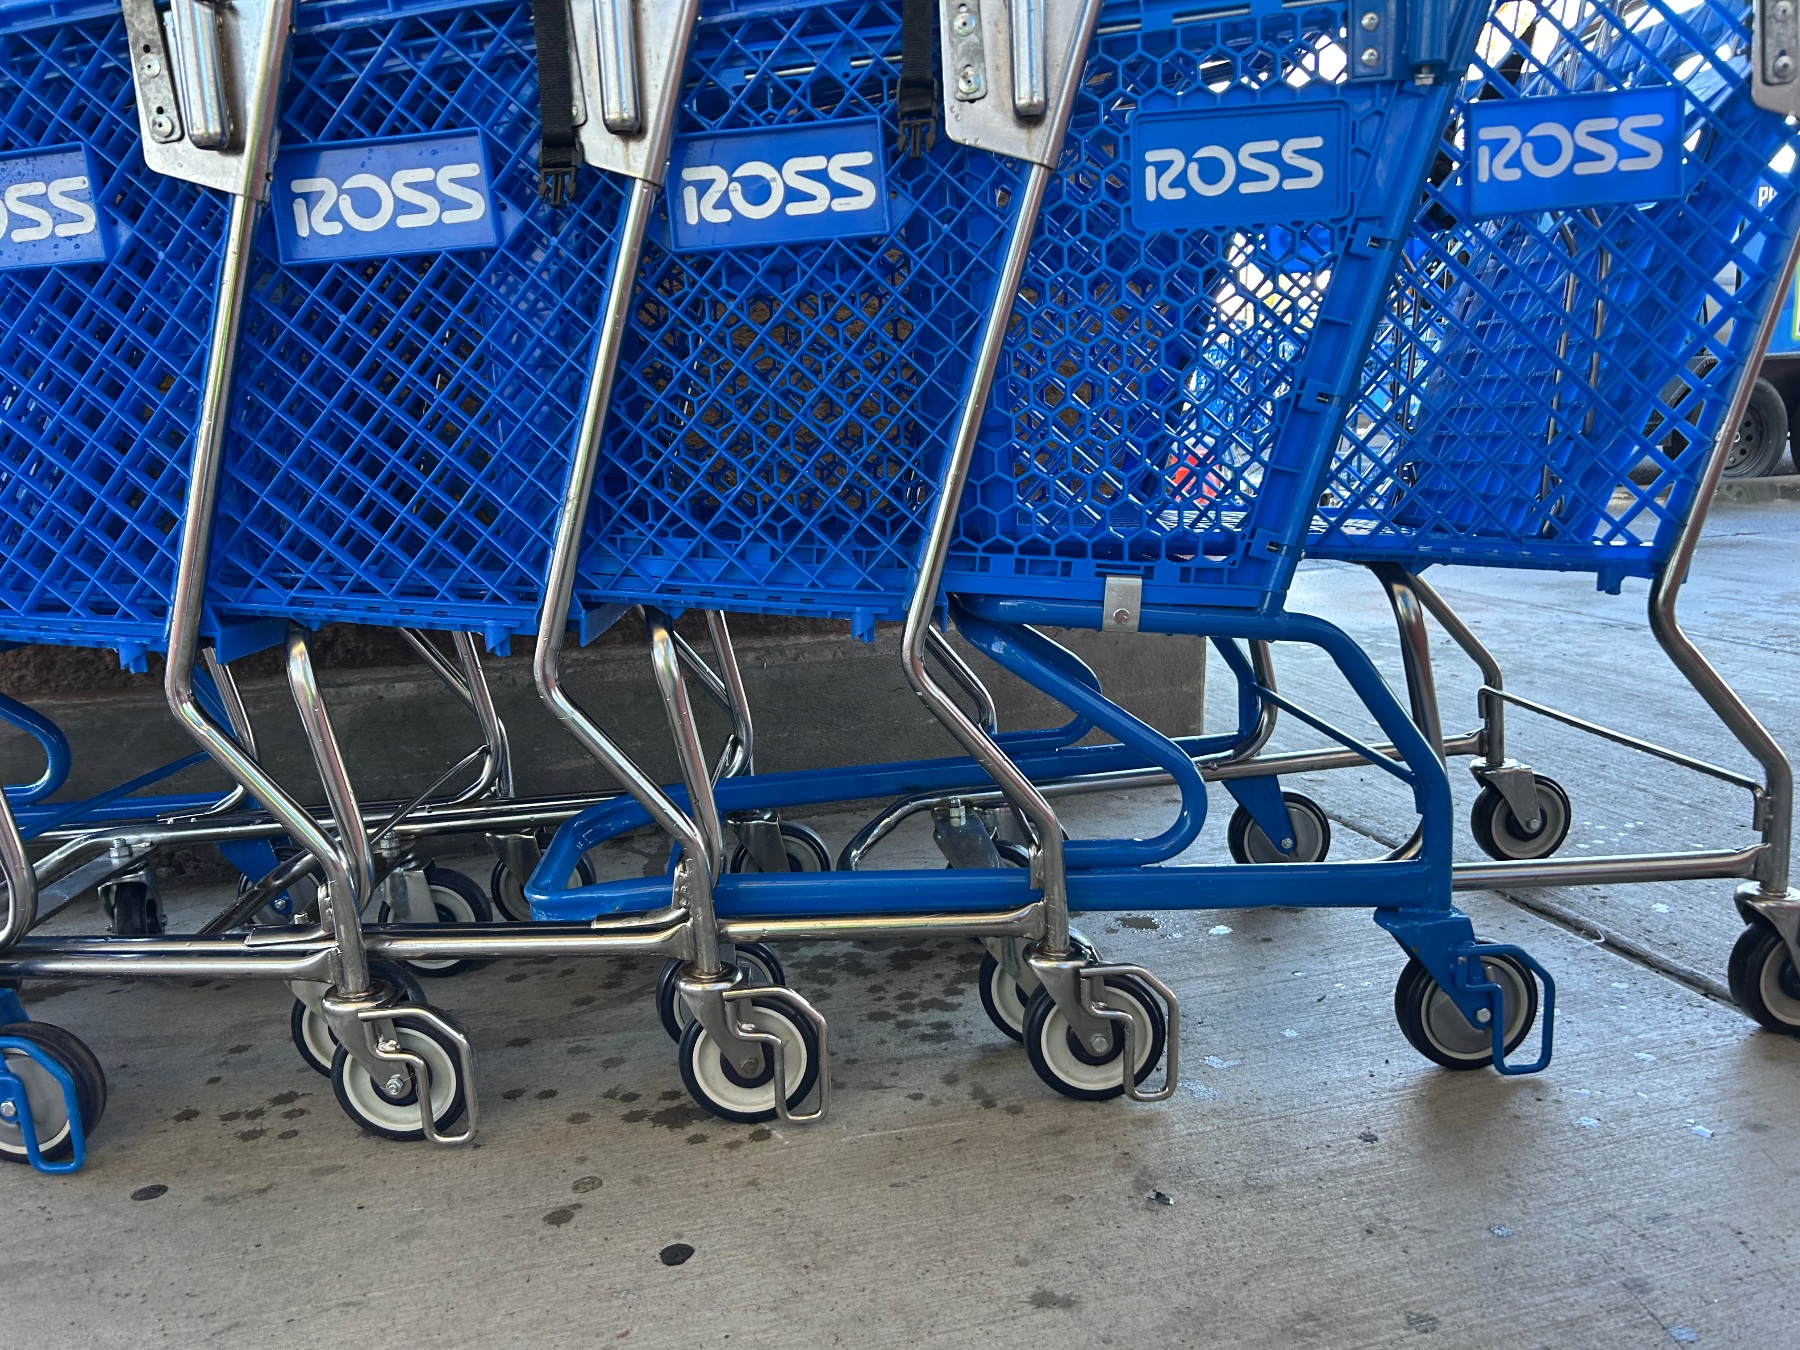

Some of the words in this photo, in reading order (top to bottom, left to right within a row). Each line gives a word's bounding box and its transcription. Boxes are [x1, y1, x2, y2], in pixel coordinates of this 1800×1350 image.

[1145, 136, 1323, 201] ROSS
[1478, 114, 1663, 182] ROSS
[0, 175, 96, 243] SS
[291, 163, 487, 238] ROSS
[682, 151, 877, 225] ROSS
